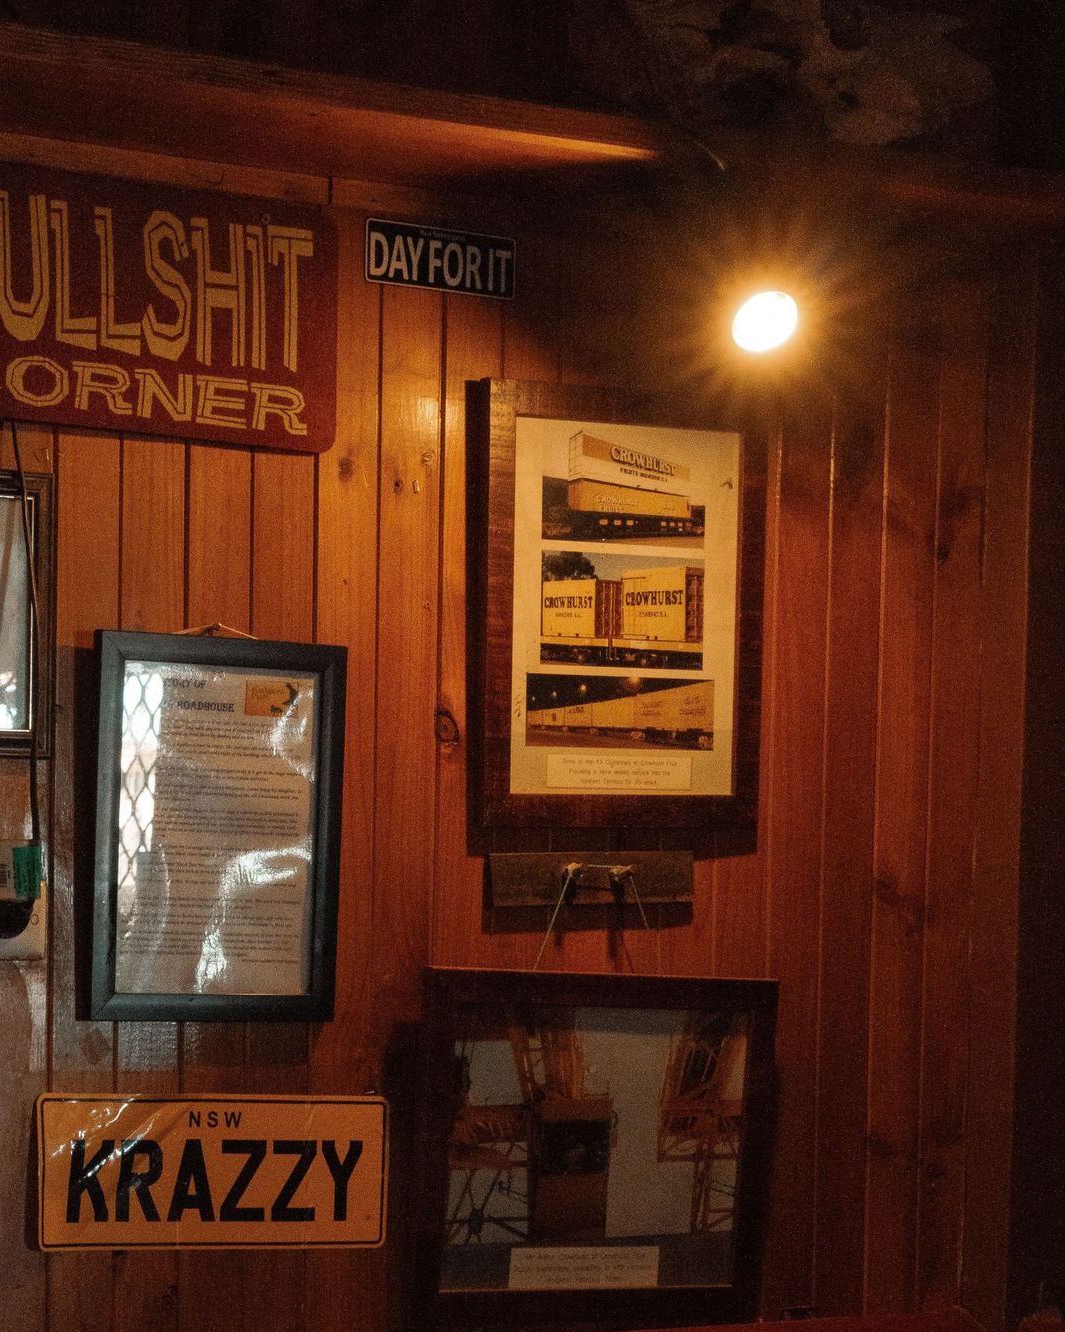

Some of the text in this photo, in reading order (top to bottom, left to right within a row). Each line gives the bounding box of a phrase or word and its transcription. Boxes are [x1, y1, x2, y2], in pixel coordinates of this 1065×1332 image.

[369, 231, 512, 293] DAY FOR IT
[610, 446, 676, 477] CROWHURST
[544, 595, 594, 609] CROWHURST
[625, 589, 685, 607] CROWHURST
[176, 699, 235, 713] ROADHOUSE
[188, 1110, 243, 1129] NSW
[65, 1138, 364, 1224] KRAZZY
